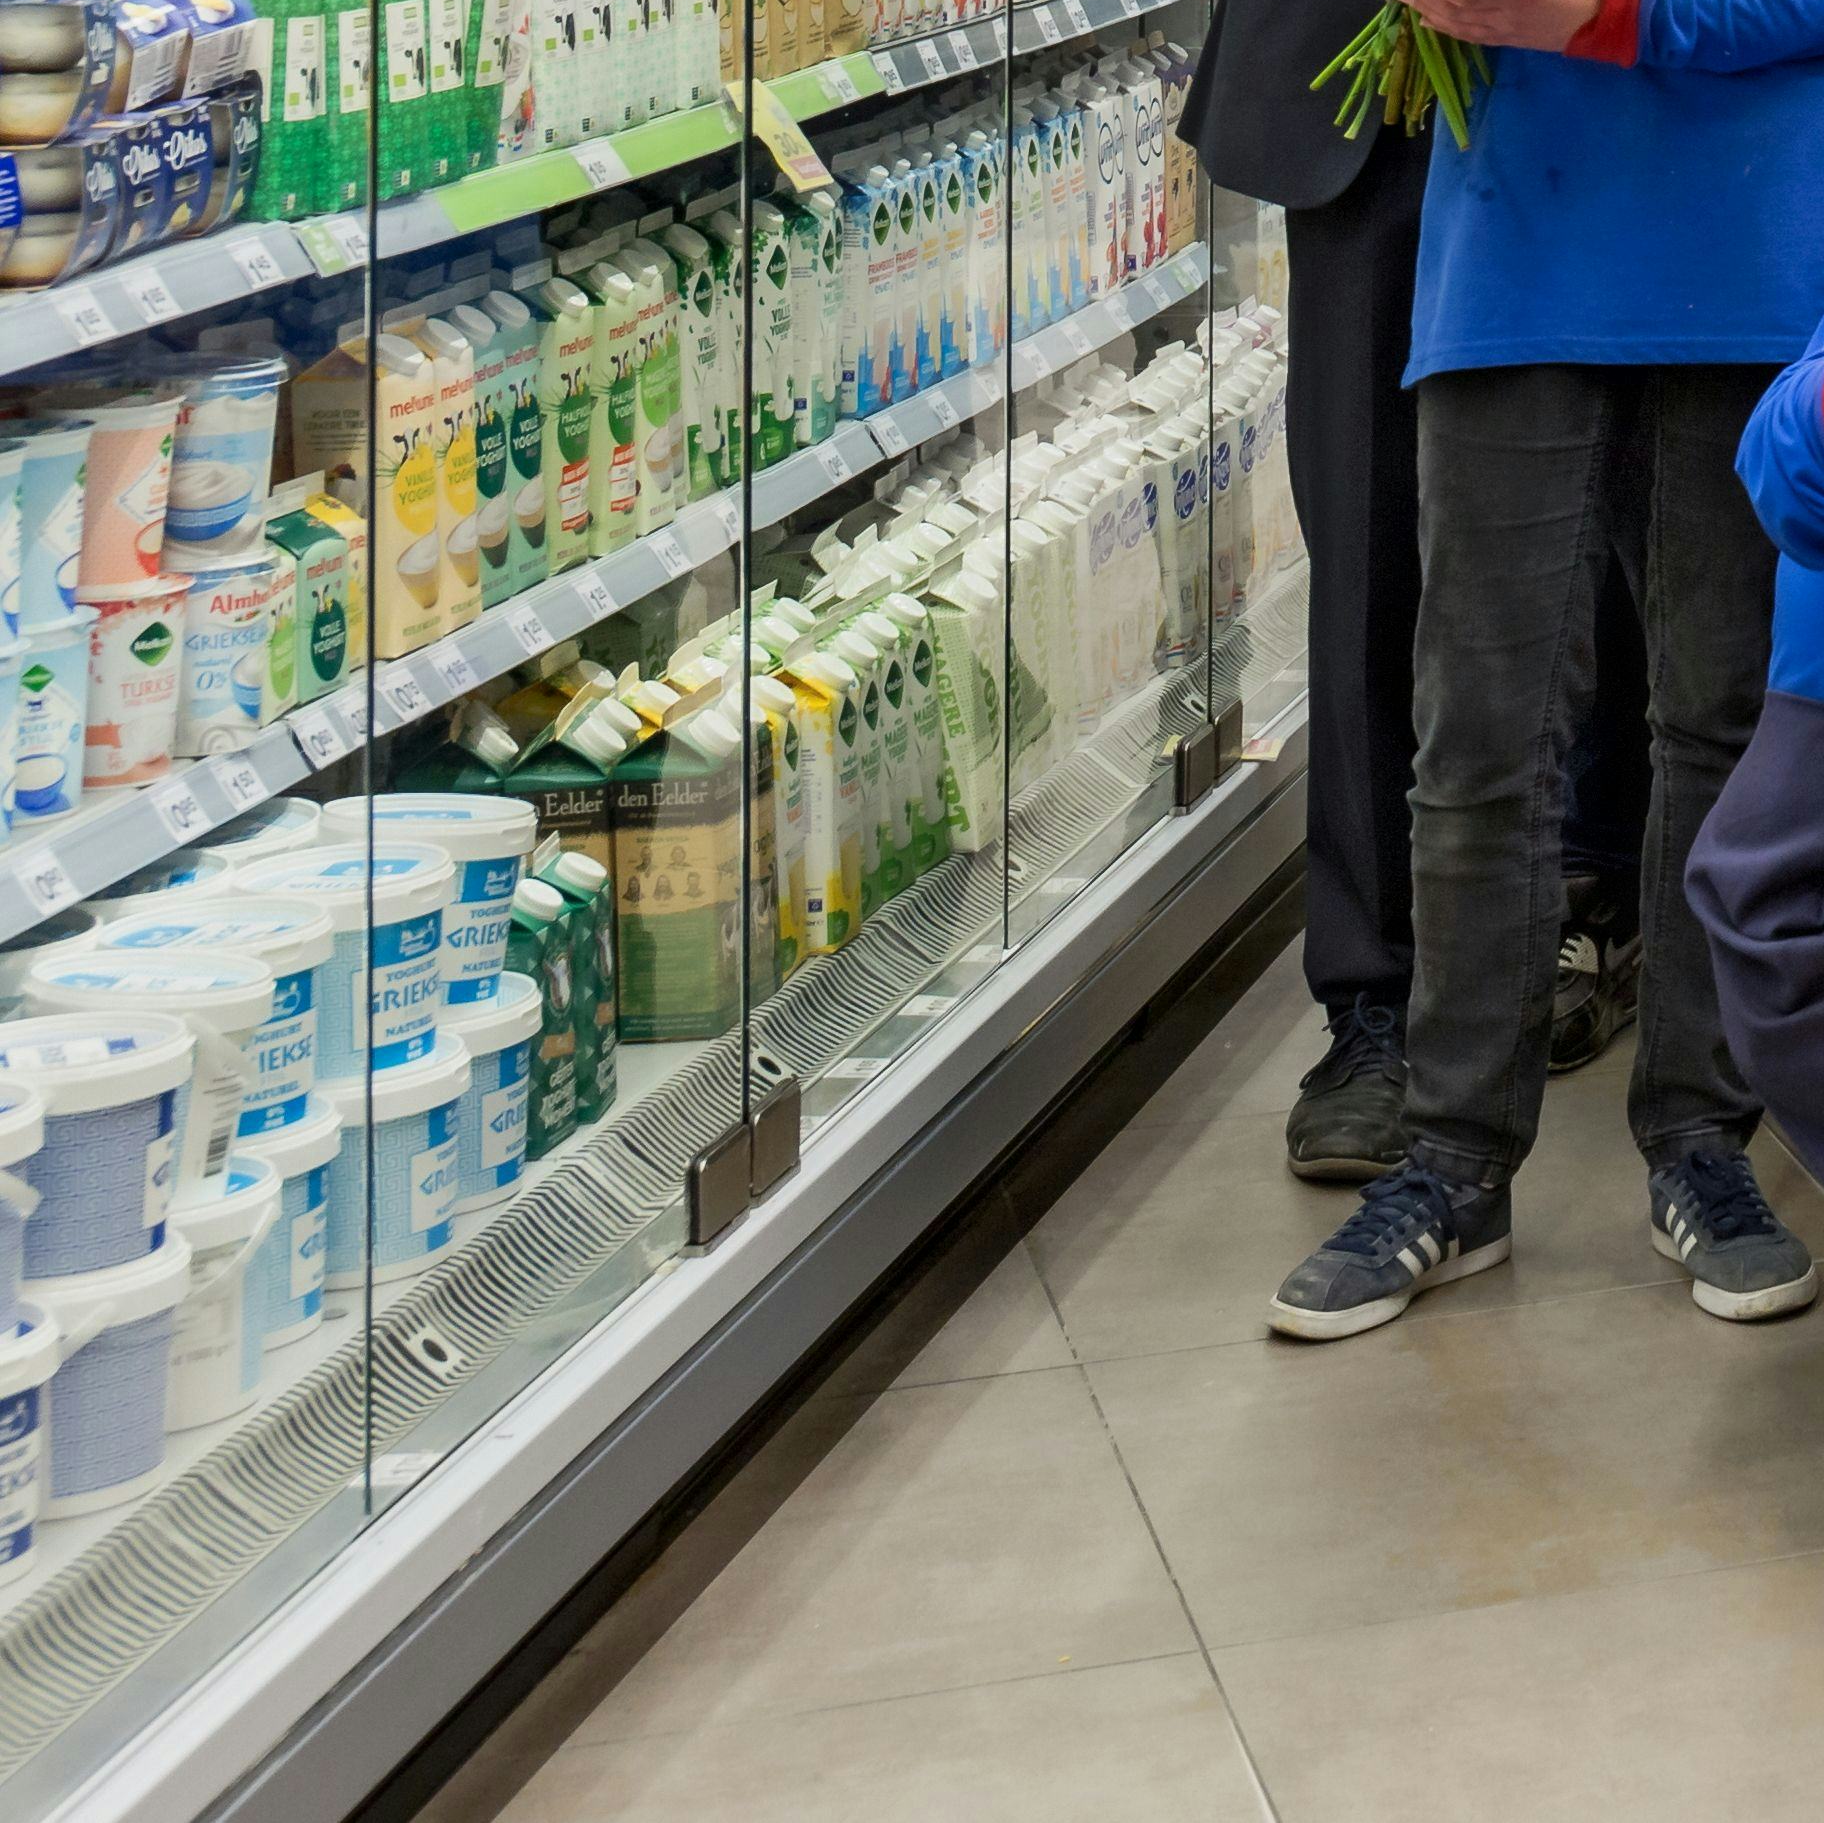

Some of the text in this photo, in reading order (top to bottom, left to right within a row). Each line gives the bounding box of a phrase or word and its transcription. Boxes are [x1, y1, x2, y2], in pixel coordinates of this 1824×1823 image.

[313, 634, 347, 656] YOGHURT
[318, 624, 342, 641] VOLLE
[545, 788, 603, 816] Eelder
[618, 780, 706, 808] den Eelder
